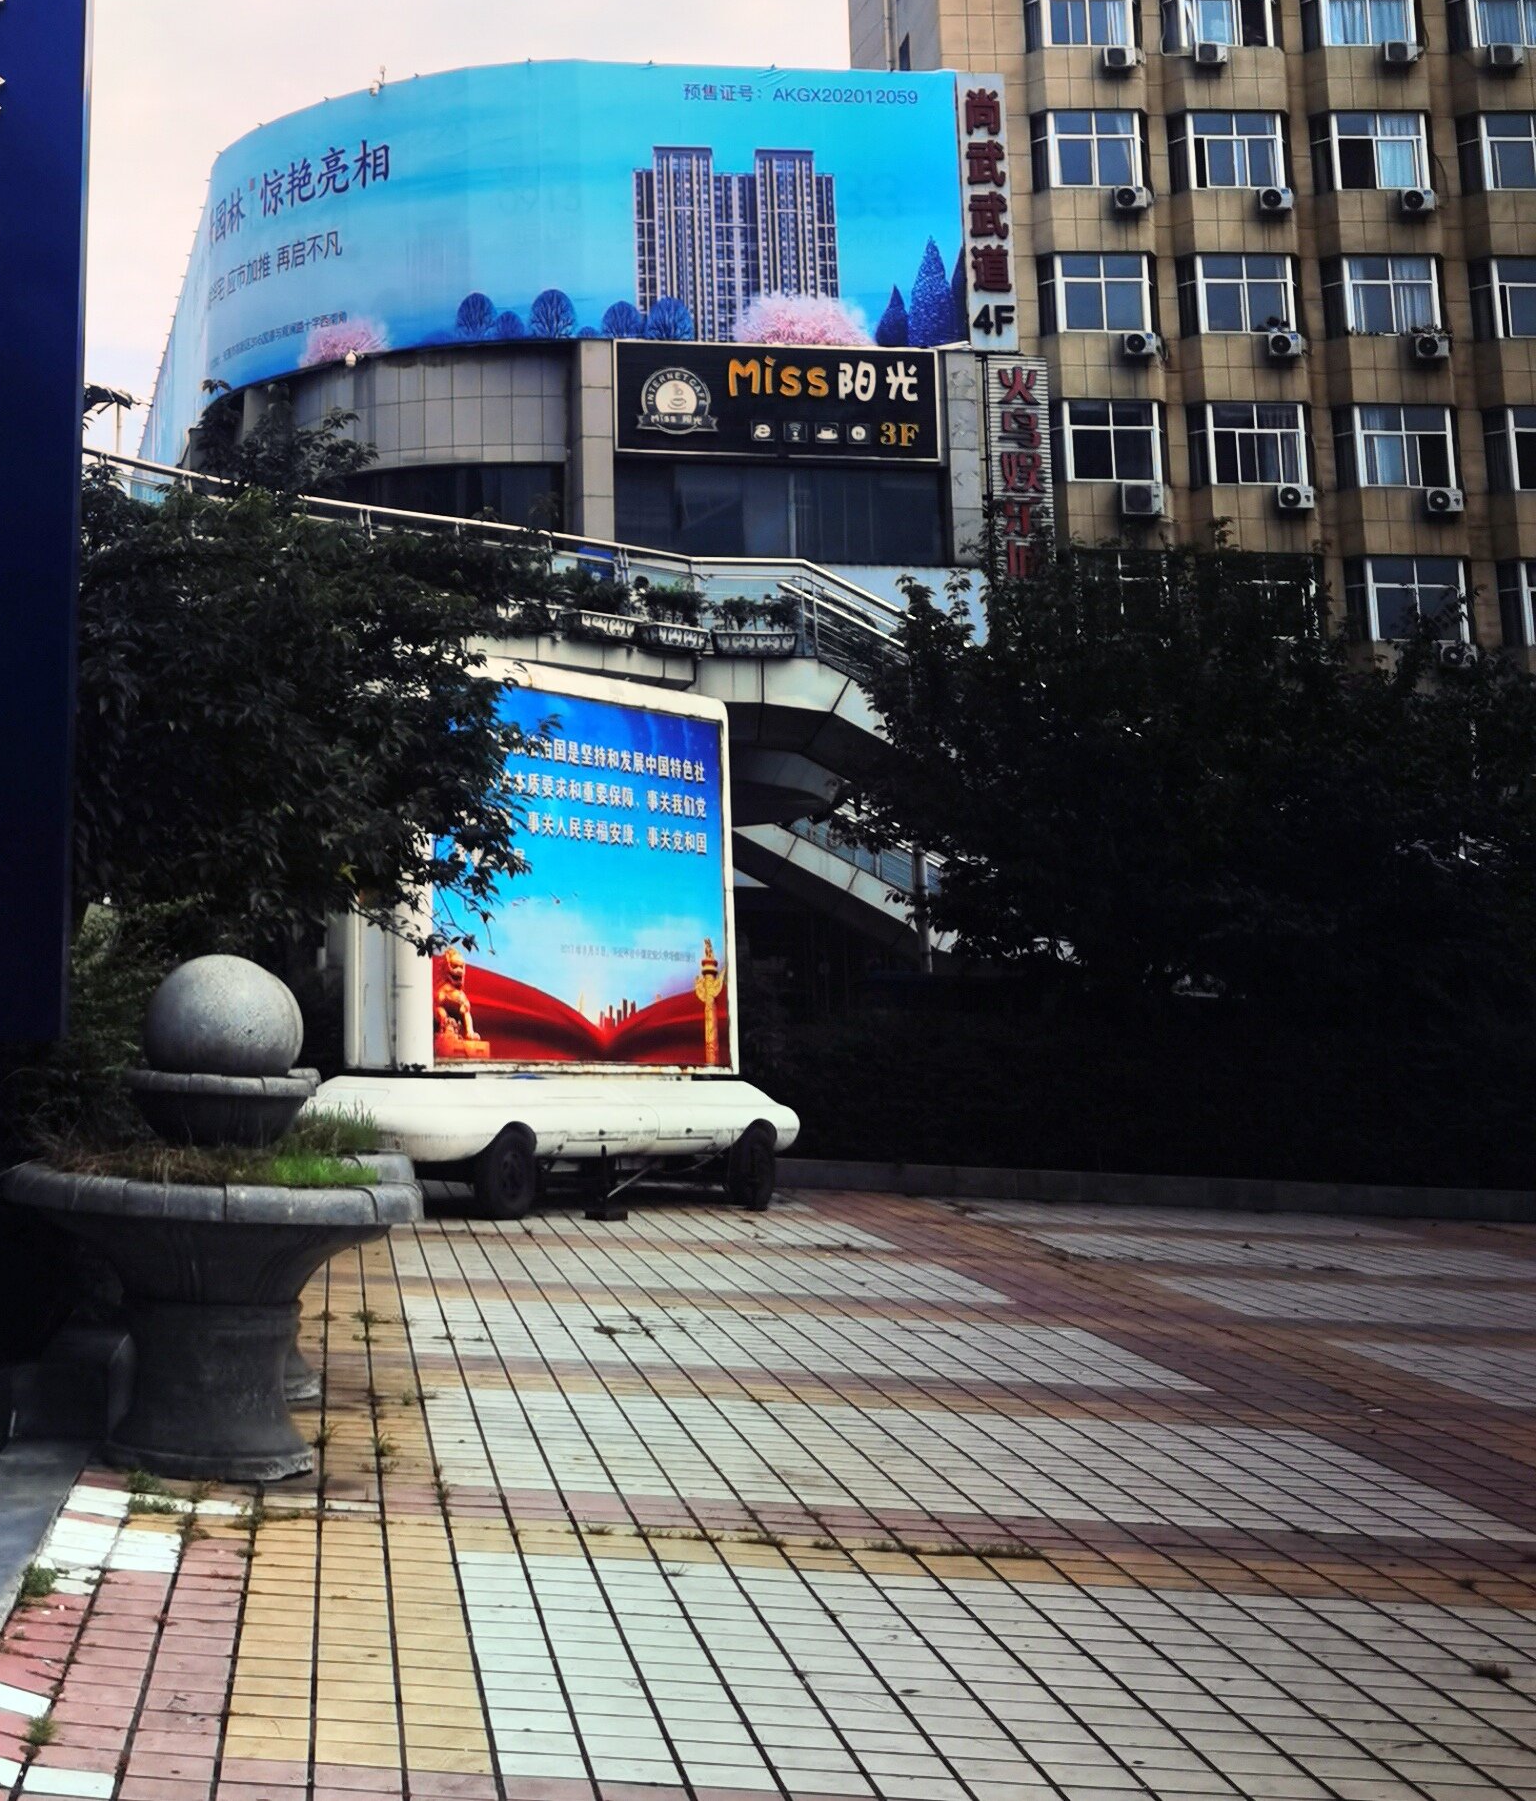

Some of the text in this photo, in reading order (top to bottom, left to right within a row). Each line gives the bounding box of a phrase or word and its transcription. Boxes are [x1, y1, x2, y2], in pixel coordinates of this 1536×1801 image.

[259, 139, 391, 219] 惊艳亮相
[963, 87, 1016, 337] 尚武武道 4F
[277, 230, 343, 274] 再启不凡
[728, 356, 920, 403] Miss 阳光
[879, 421, 920, 448] 3F
